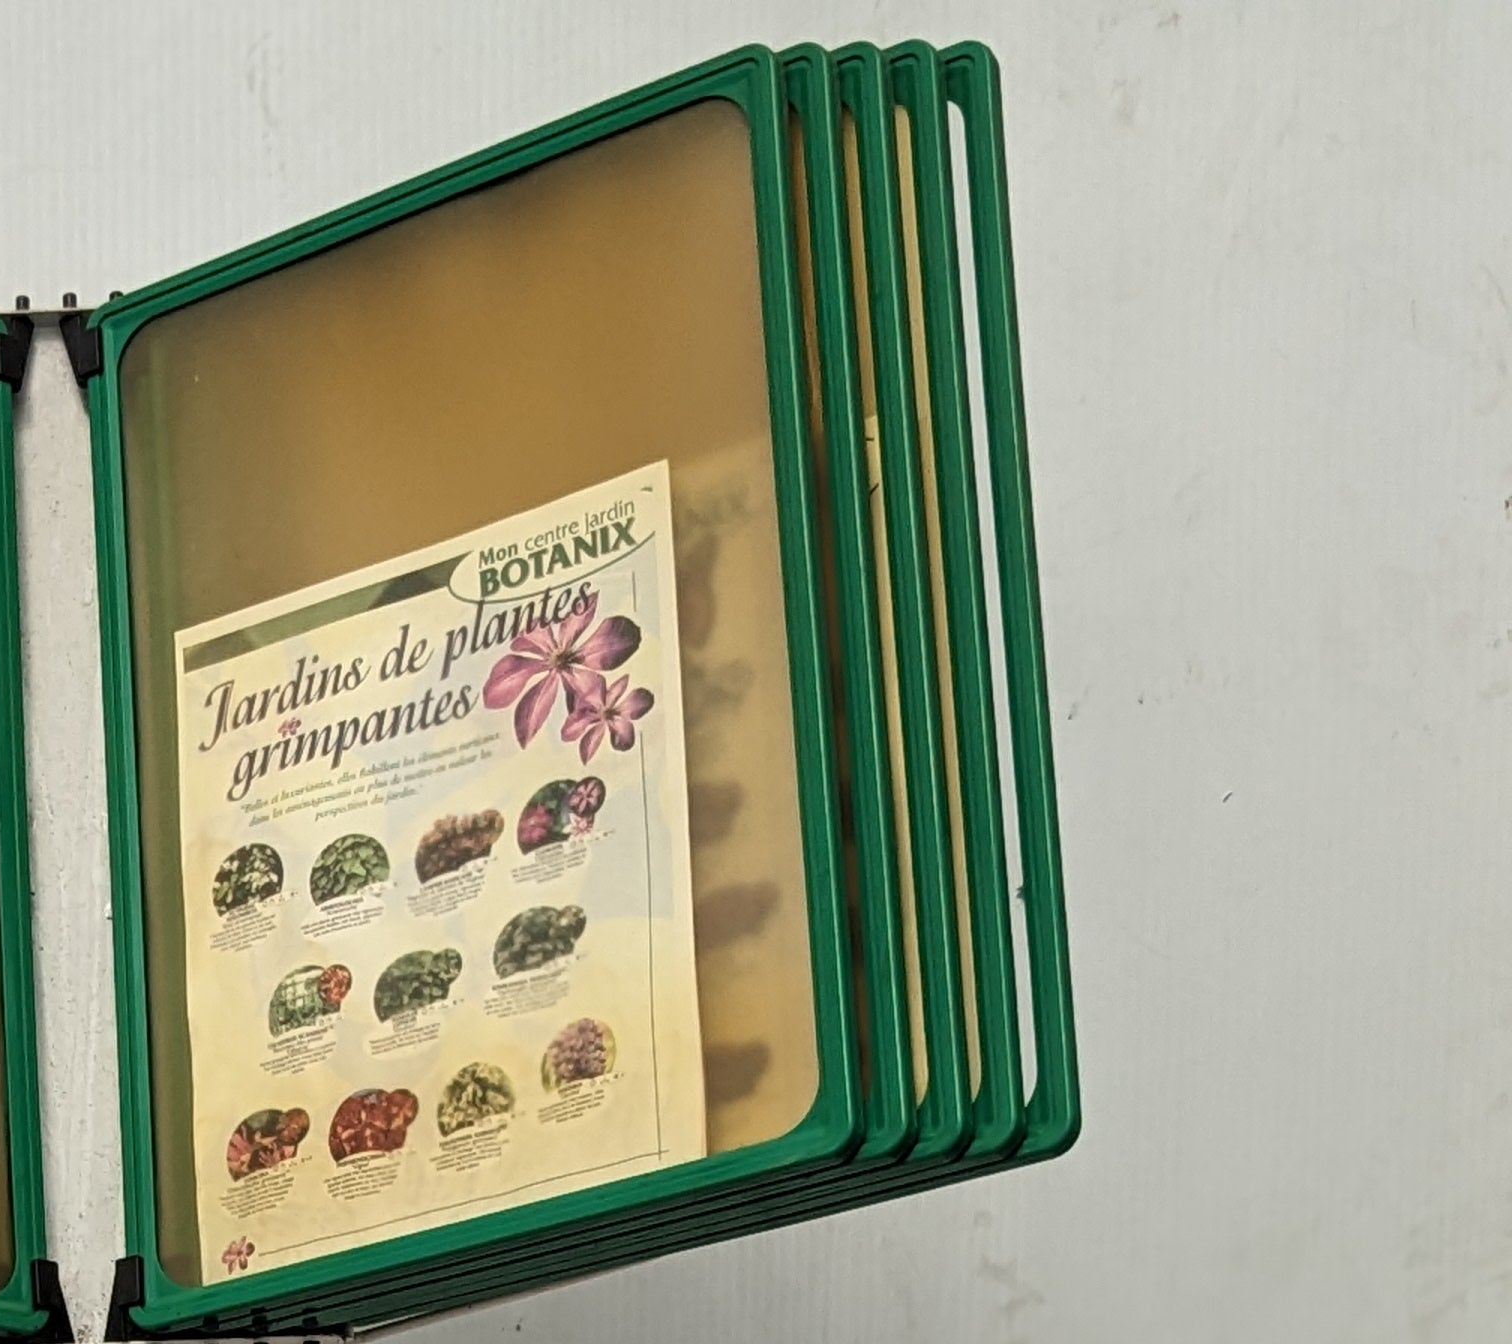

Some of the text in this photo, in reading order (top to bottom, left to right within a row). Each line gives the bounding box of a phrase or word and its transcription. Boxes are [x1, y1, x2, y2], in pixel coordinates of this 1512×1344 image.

[478, 543, 518, 569] Mon
[524, 520, 580, 552] centre
[584, 500, 636, 536] jardin
[479, 517, 638, 598] BOTANIX
[198, 581, 592, 753] Jardins de plantes
[226, 682, 481, 802] grimpantes
